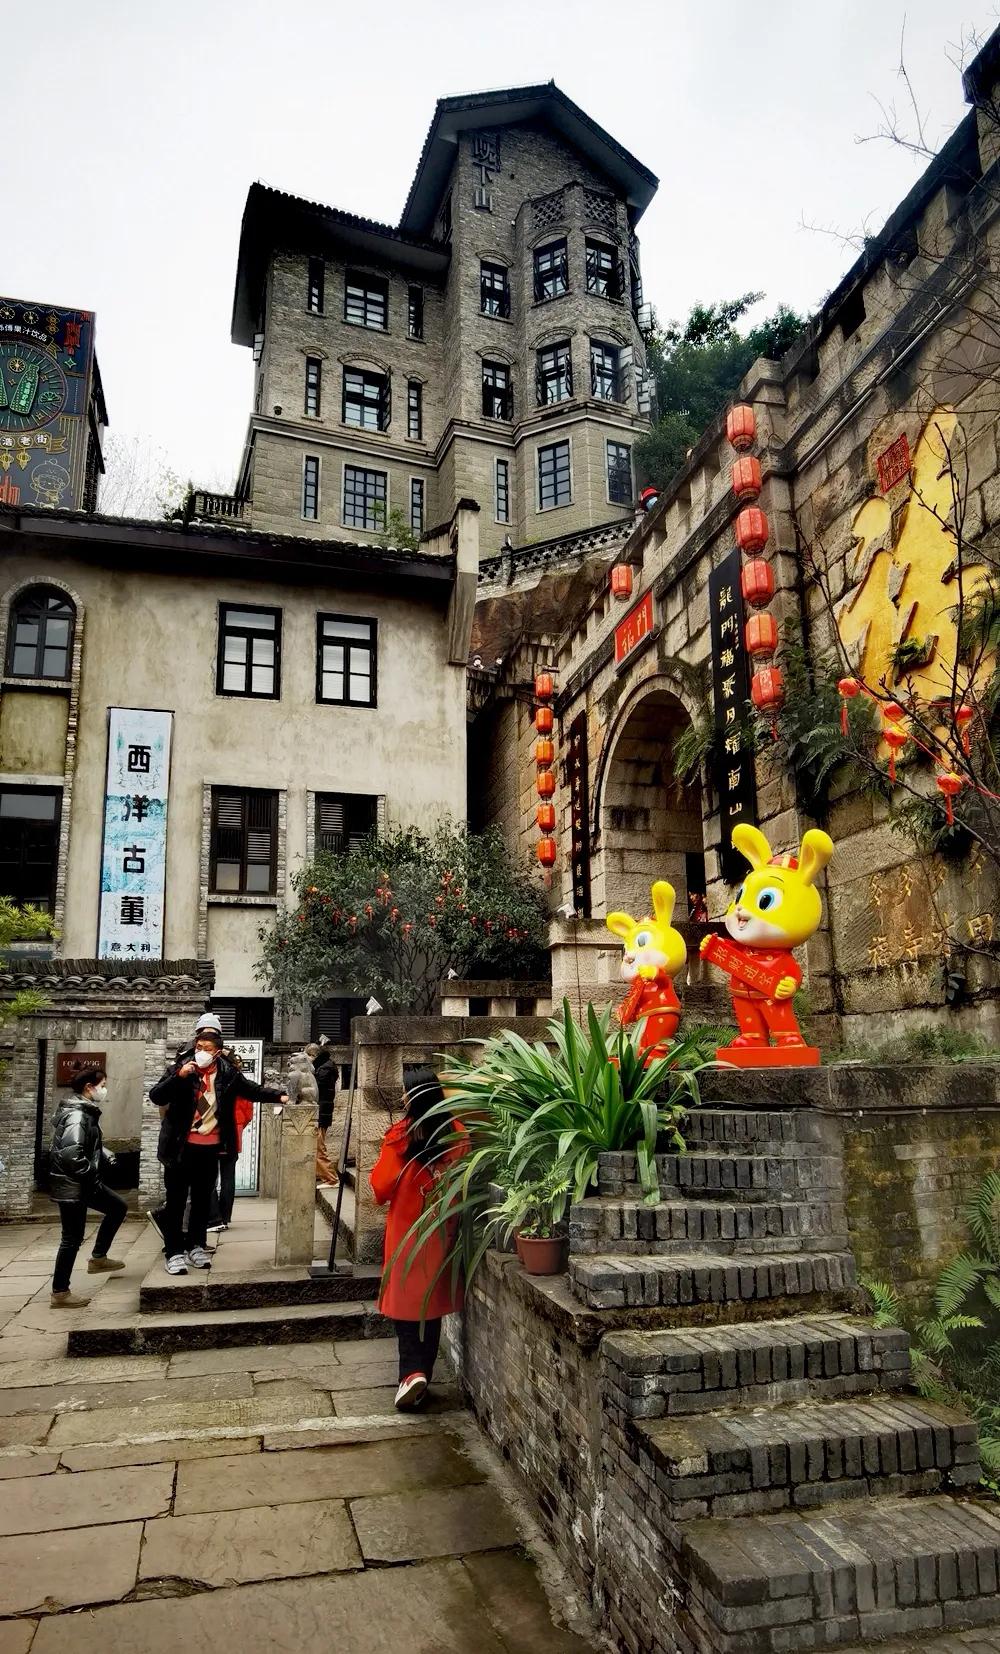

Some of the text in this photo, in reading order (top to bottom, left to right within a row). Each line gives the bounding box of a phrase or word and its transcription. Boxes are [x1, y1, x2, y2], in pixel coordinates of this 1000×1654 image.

[120, 744, 151, 926] 西洋古董
[110, 942, 151, 952] 意大利
